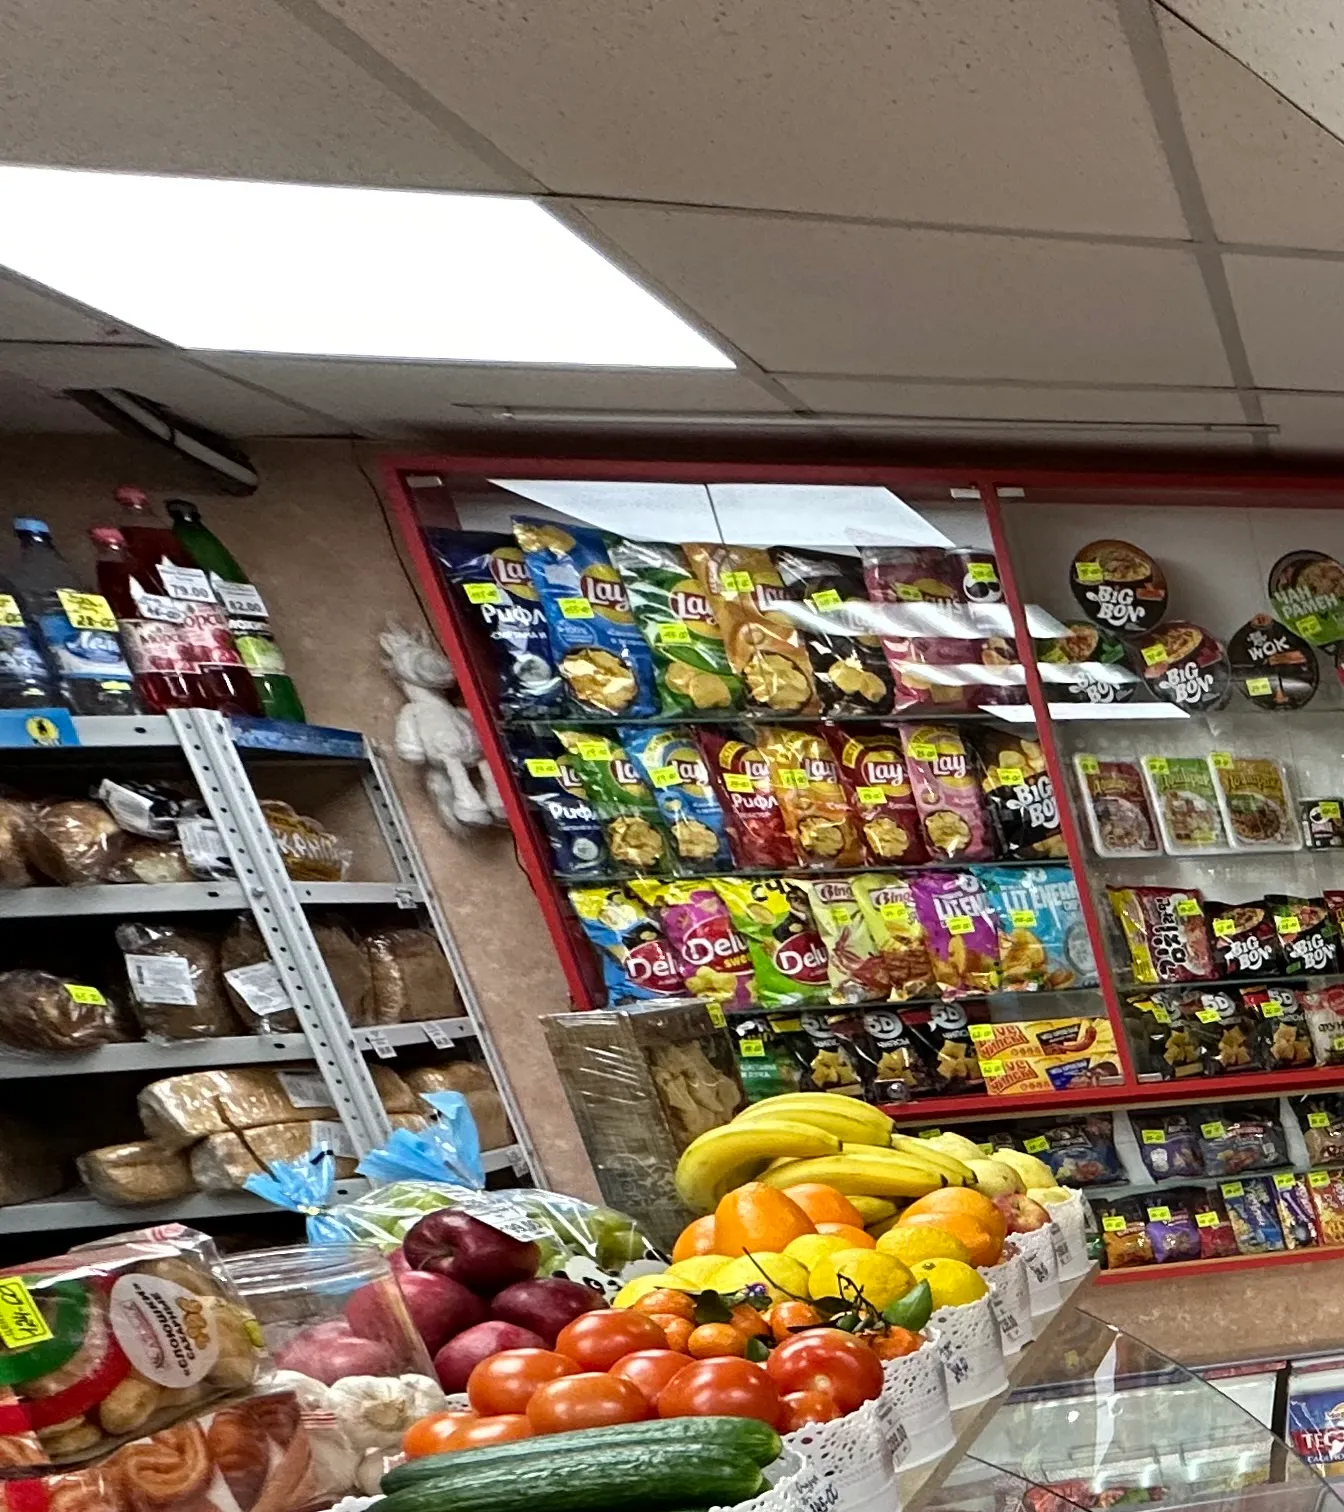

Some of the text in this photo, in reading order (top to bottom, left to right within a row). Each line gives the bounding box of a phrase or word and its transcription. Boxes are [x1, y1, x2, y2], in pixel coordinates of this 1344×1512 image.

[585, 577, 629, 613] Lay
[481, 602, 547, 626] Рифл
[1247, 634, 1291, 662] WOK
[731, 793, 780, 811] Рифл
